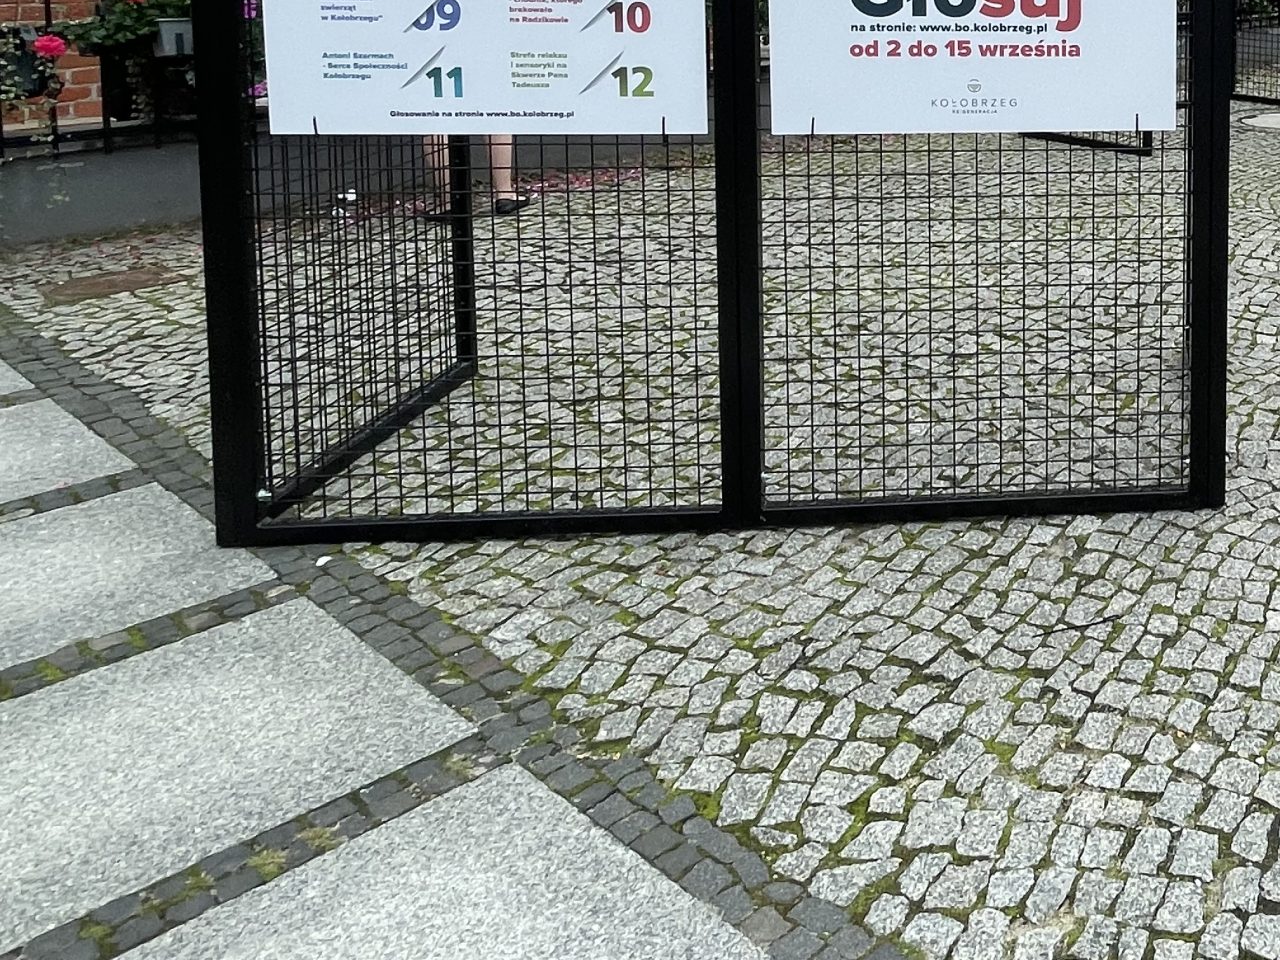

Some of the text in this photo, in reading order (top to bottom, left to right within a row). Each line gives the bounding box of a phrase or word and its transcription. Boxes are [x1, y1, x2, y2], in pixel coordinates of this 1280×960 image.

[605, 0, 652, 34] 10
[849, 39, 1081, 57] od 2 do 15 września
[425, 65, 464, 98] 11
[609, 65, 655, 98] 12
[930, 97, 1018, 108] KOŁOBRZEG
